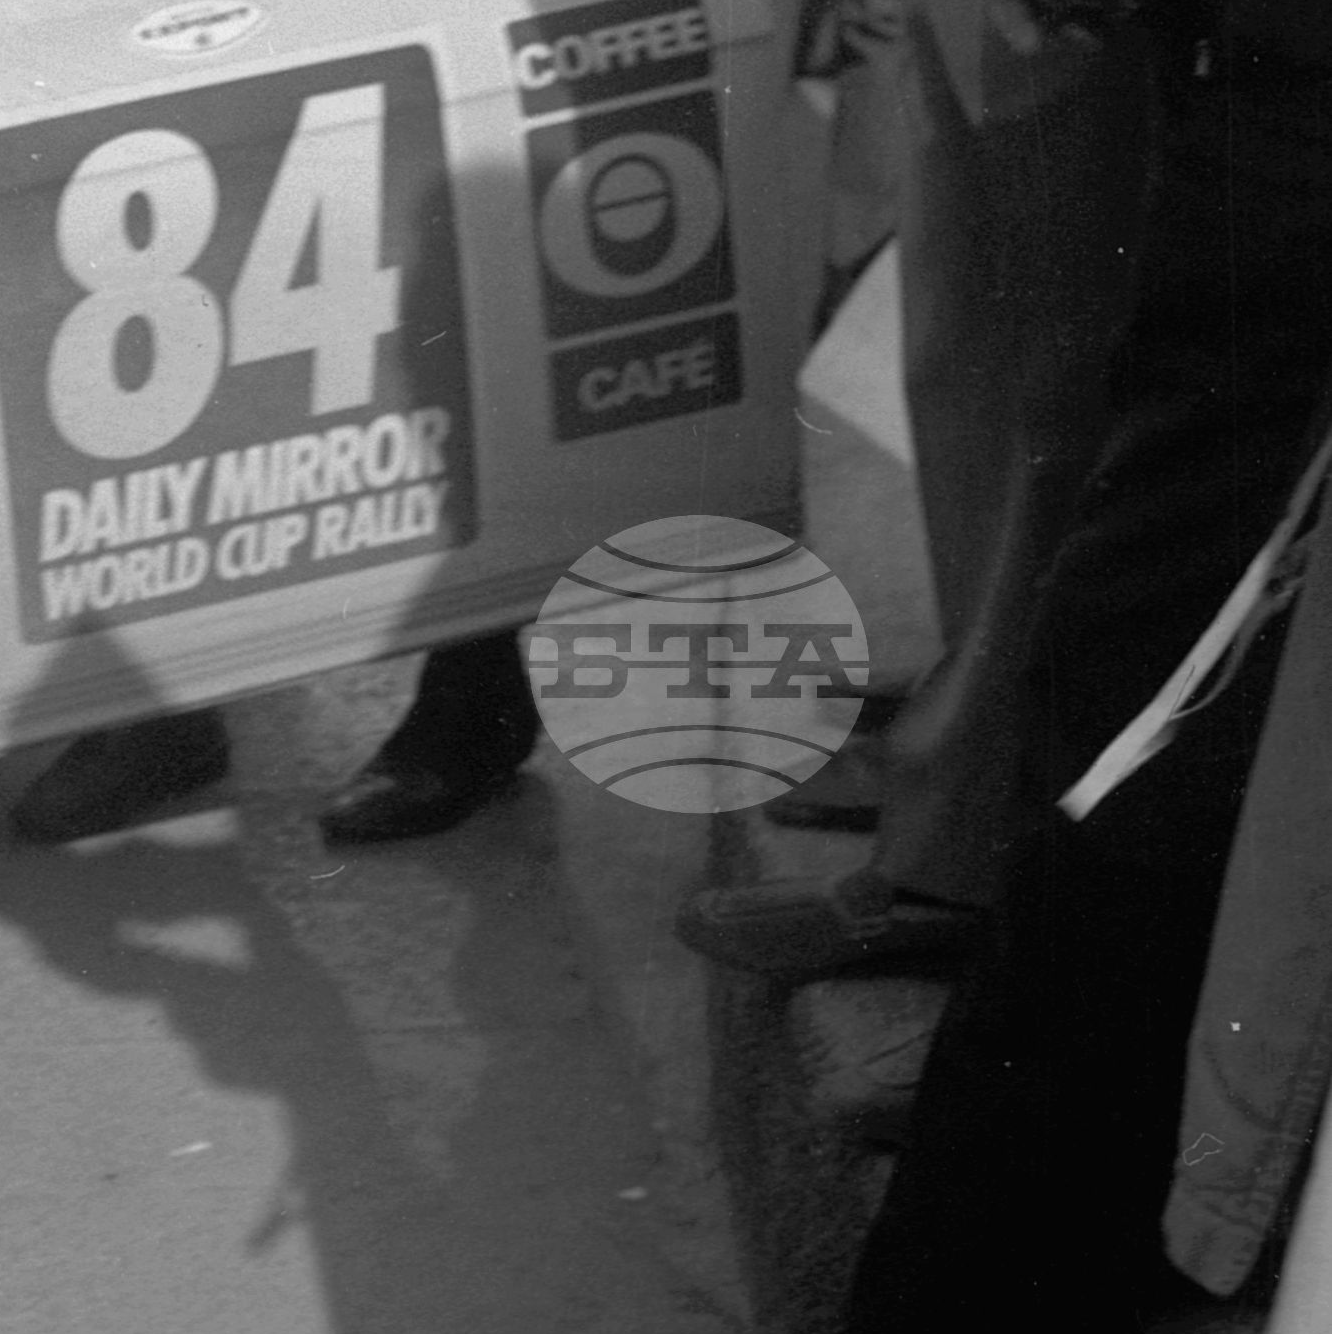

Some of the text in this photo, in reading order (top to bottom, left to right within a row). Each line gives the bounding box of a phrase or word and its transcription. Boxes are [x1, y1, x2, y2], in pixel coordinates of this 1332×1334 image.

[516, 7, 708, 90] COFFEE
[45, 82, 403, 461] 84
[40, 406, 451, 564] DAILY MIRROR
[40, 479, 449, 622] WORLD CUP RALLY
